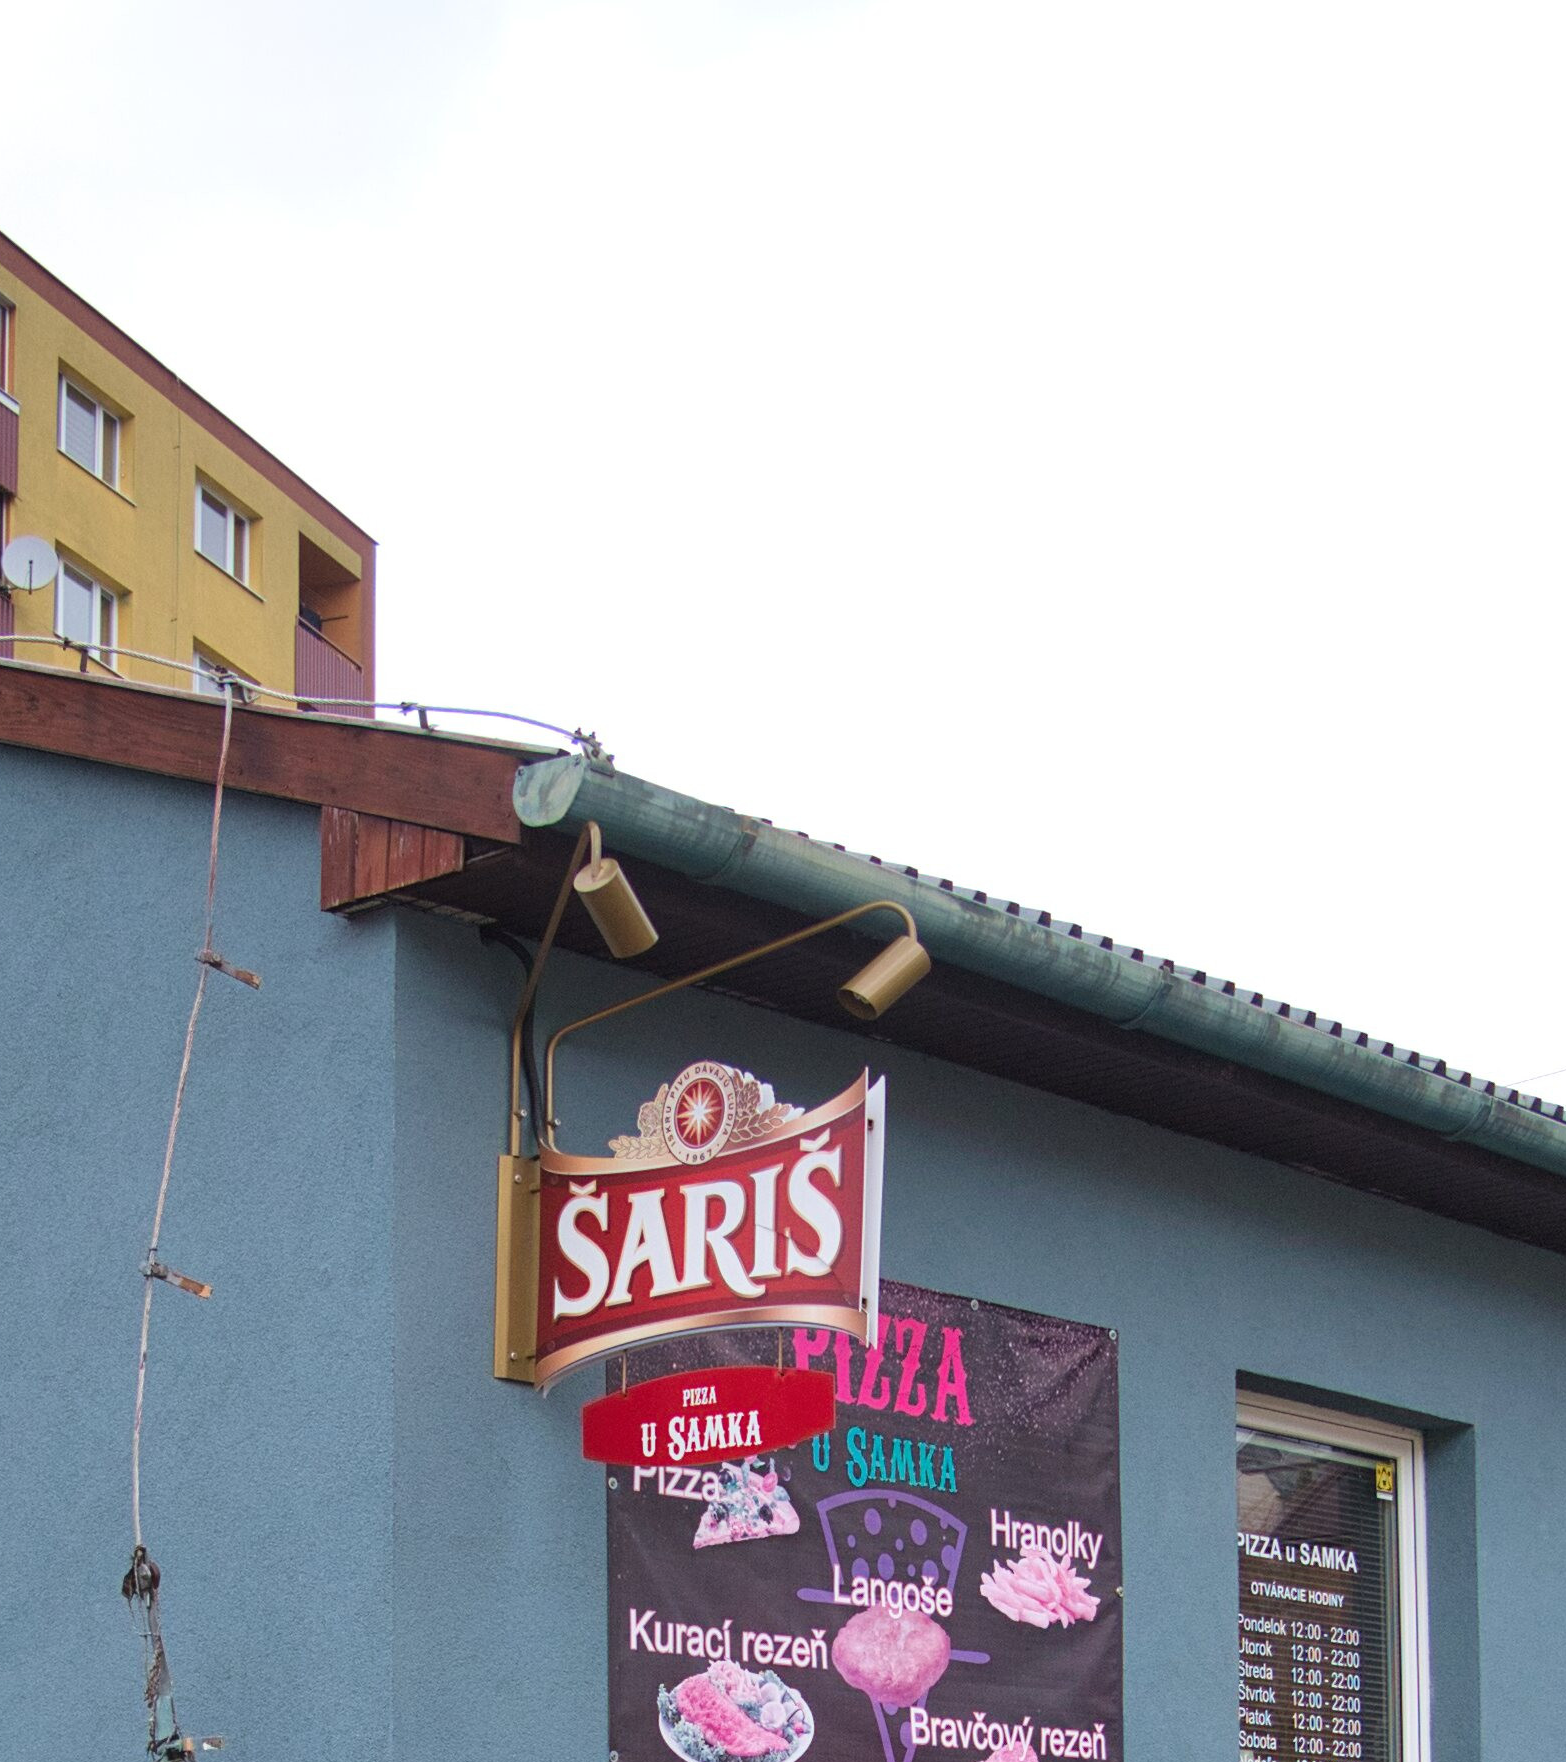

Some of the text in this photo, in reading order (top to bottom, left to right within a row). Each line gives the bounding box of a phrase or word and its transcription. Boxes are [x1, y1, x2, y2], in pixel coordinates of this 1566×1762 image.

[665, 1106, 675, 1147] ISKRU
[670, 1072, 690, 1098] PIVU
[685, 1148, 712, 1162] 1967
[553, 1128, 843, 1323] ŠARIŠ
[681, 1386, 717, 1407] PIZZA
[641, 1410, 763, 1461] U SAMKA
[812, 1426, 958, 1493] U SAMKA
[989, 1508, 1104, 1570] Hranolky
[1237, 1532, 1358, 1573] PIZZA u SAMKA
[833, 1563, 954, 1620] Langoše
[1250, 1581, 1345, 1608] OTVÁRACIE HODINY
[629, 1608, 829, 1670] Kurací rezeň
[1238, 1613, 1286, 1635] Pondelok
[1291, 1621, 1321, 1640] 12:00
[1330, 1627, 1360, 1646] 22:00
[1291, 1644, 1321, 1663] 12:00
[1331, 1650, 1360, 1668] 22:00
[1238, 1660, 1273, 1680] Streda
[1291, 1667, 1322, 1686] 12:00
[1331, 1672, 1360, 1691] 22:00
[1238, 1680, 1276, 1703] Štvrtok
[1292, 1690, 1322, 1709] 12:00
[1332, 1695, 1361, 1713] 22:00
[909, 1706, 1108, 1762] Bravčový rezeň
[1238, 1706, 1272, 1726] Piatok
[1292, 1713, 1323, 1732] 12:00
[1332, 1717, 1361, 1736] 22:00
[1238, 1730, 1277, 1750] Sobota
[1292, 1736, 1323, 1755] 12:00
[1333, 1741, 1361, 1758] 22:00
